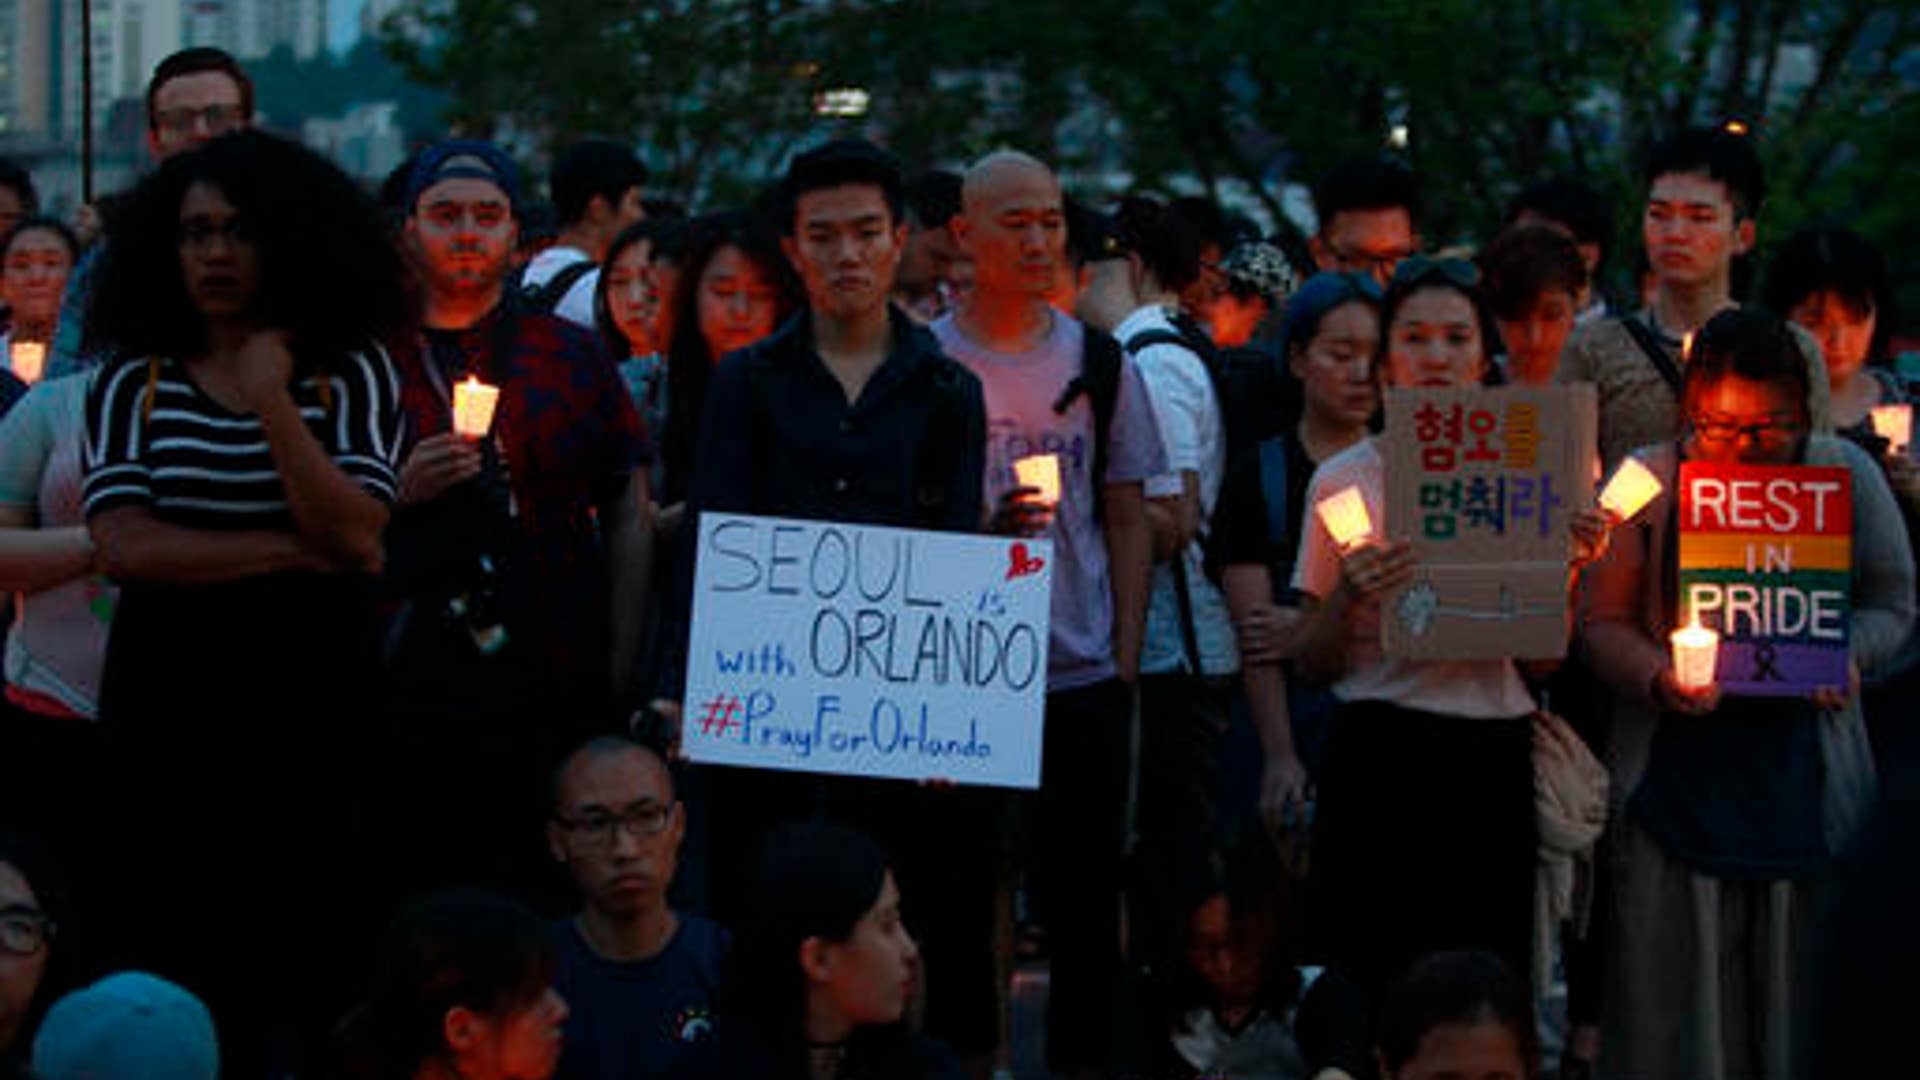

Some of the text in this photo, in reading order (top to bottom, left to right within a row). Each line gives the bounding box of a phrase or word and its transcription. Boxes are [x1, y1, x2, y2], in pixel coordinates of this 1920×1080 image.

[1413, 402, 1544, 472] 혐오를
[1690, 478, 1841, 532] REST
[710, 520, 943, 607] SEOUL
[1746, 543, 1794, 574] IN
[1689, 583, 1847, 639] PRIDE
[715, 608, 1039, 692] with ORLANDO
[697, 691, 992, 760] #PrayForOrlando
